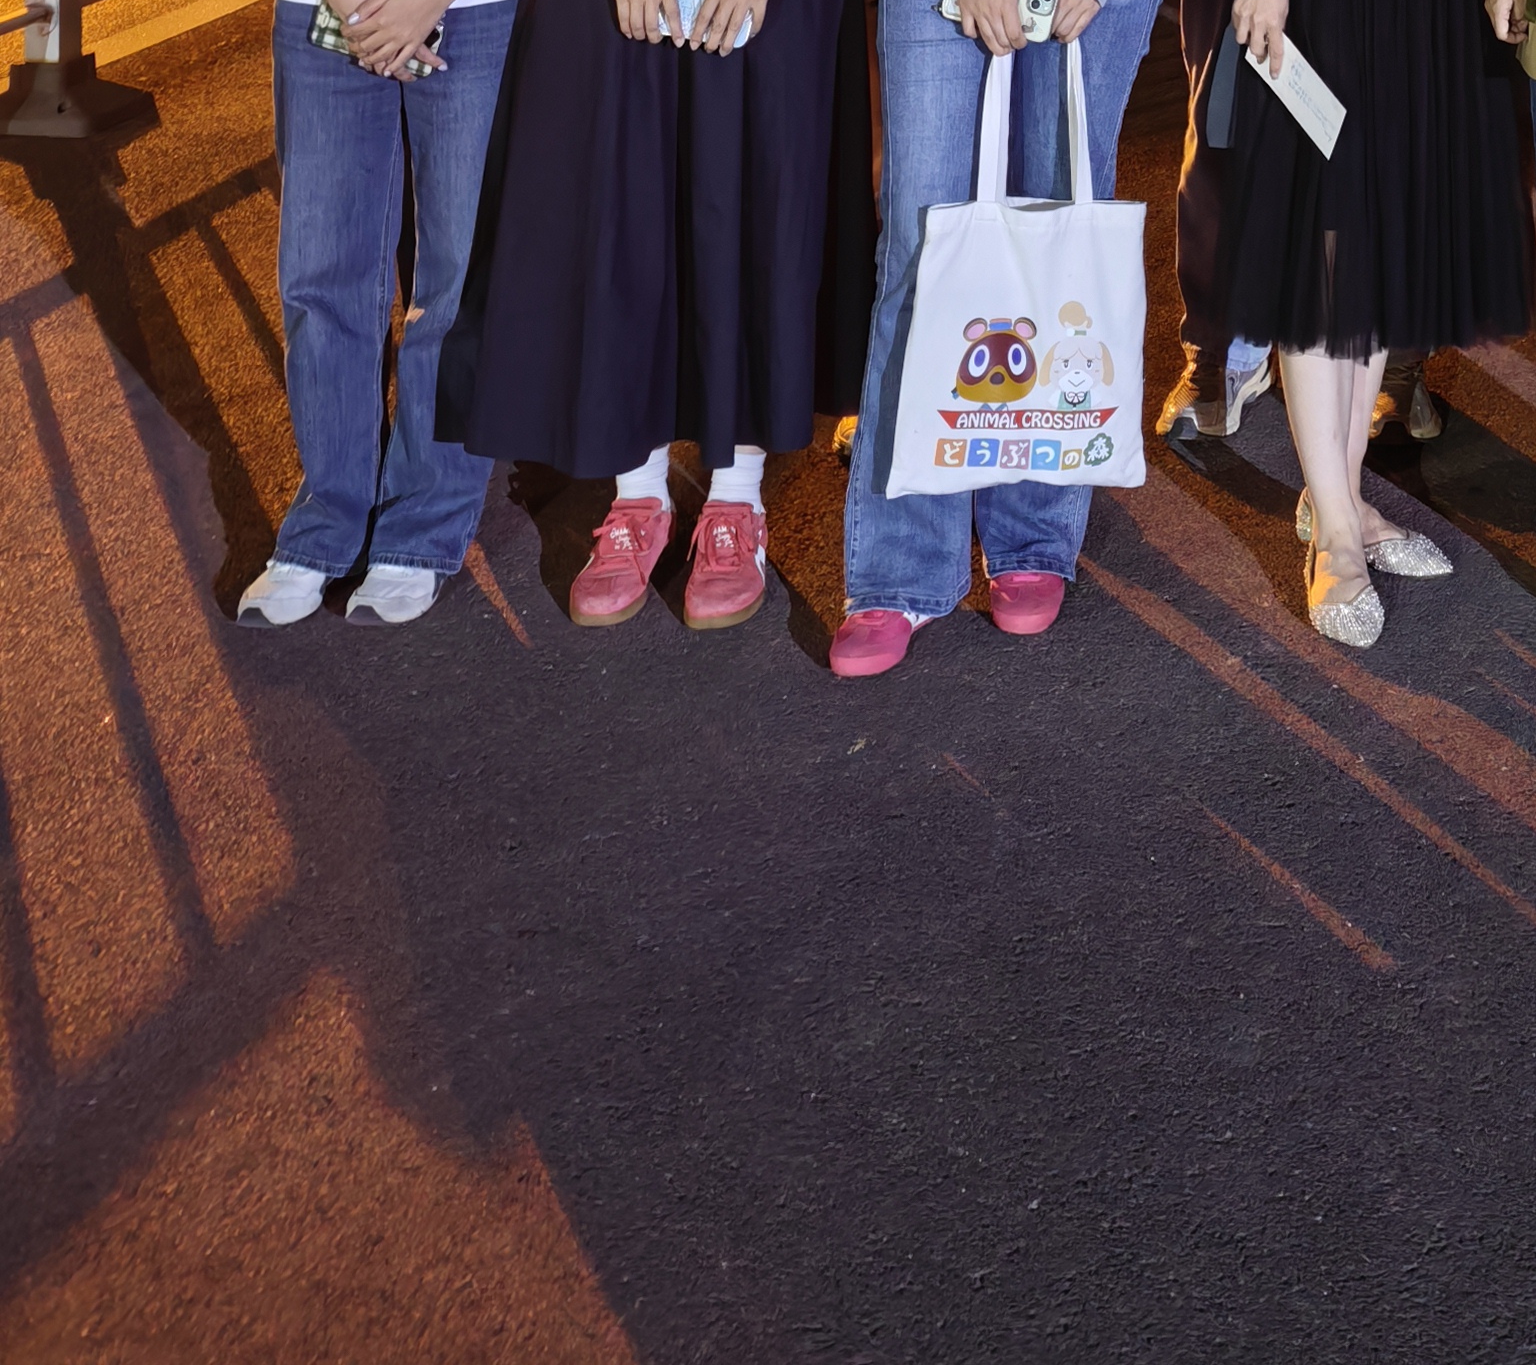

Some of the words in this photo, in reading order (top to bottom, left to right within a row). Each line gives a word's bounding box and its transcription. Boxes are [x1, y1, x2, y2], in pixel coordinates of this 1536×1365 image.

[956, 411, 1018, 429] ANIMAL
[1021, 411, 1101, 429] CROSSING
[940, 435, 1110, 468] どうぶつの森
